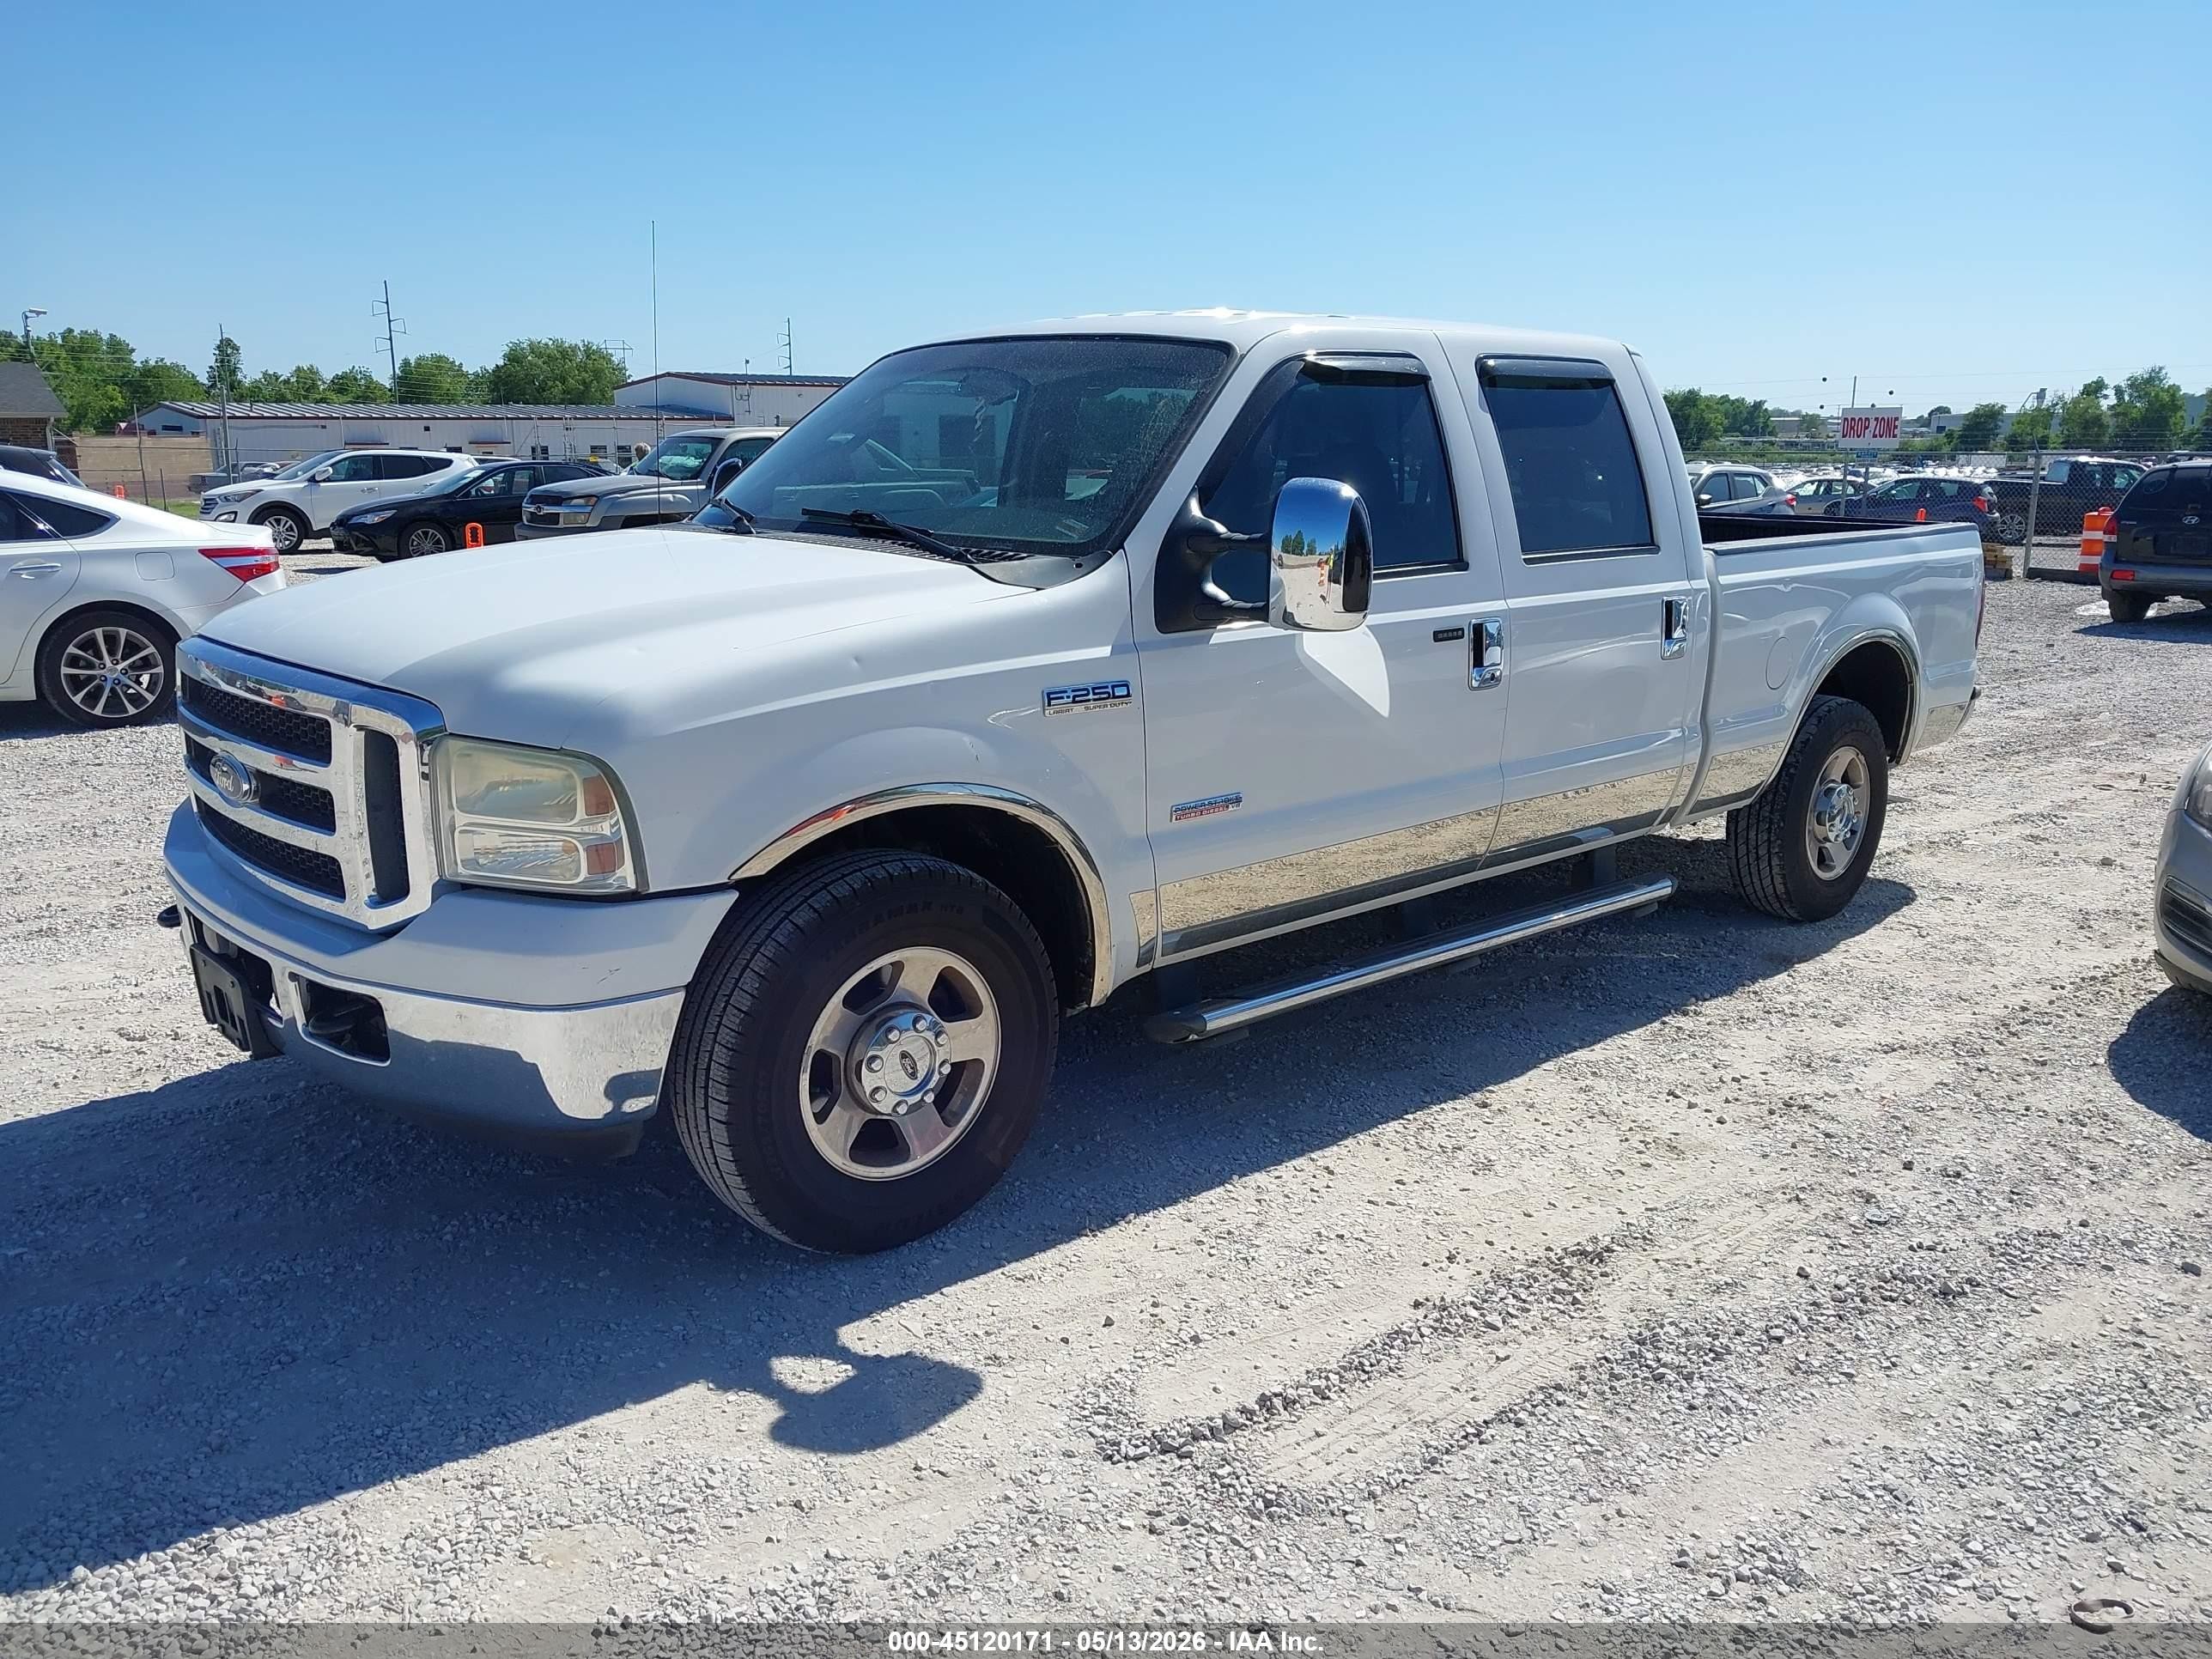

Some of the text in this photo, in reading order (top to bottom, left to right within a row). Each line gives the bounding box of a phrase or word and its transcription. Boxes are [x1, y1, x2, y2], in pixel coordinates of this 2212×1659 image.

[1842, 416, 1899, 439] DROP ZONE
[1046, 683, 1133, 708] F-250
[1048, 708, 1074, 716] LARIAT
[214, 762, 234, 792] Ford
